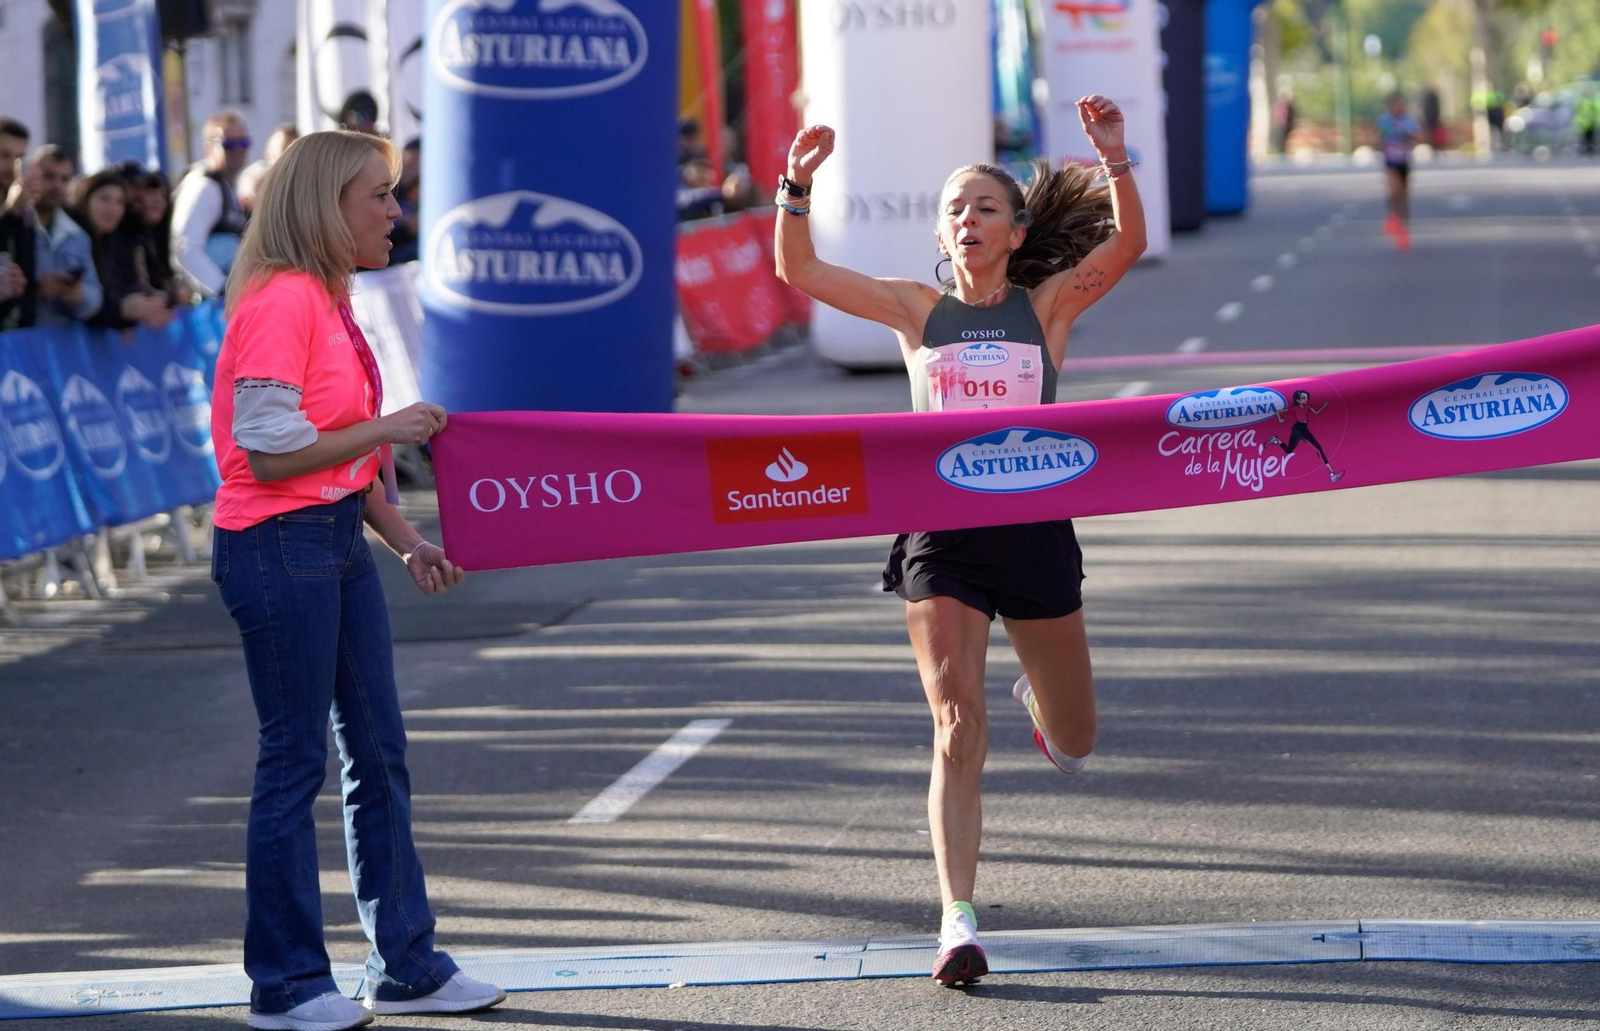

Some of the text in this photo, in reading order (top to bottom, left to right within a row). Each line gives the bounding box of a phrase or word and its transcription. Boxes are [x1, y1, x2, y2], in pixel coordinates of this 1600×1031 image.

[962, 329, 1006, 339] OYSHO
[961, 352, 1006, 361] ASTURIANA
[963, 379, 1007, 397] 016
[1444, 382, 1551, 403] CENTRAL LECHERA
[1193, 394, 1274, 408] CENTRAL LECHERA
[1421, 393, 1558, 426] ASTURIANA
[1176, 402, 1278, 423] ASTURIANA
[972, 442, 1079, 457] CENTRAL LECHERA
[1158, 429, 1257, 456] Carrera
[949, 450, 1087, 478] ASTURIANA
[1184, 444, 1296, 492] de la Mujer
[469, 469, 642, 513] OYSHO
[727, 484, 851, 511] Santander
